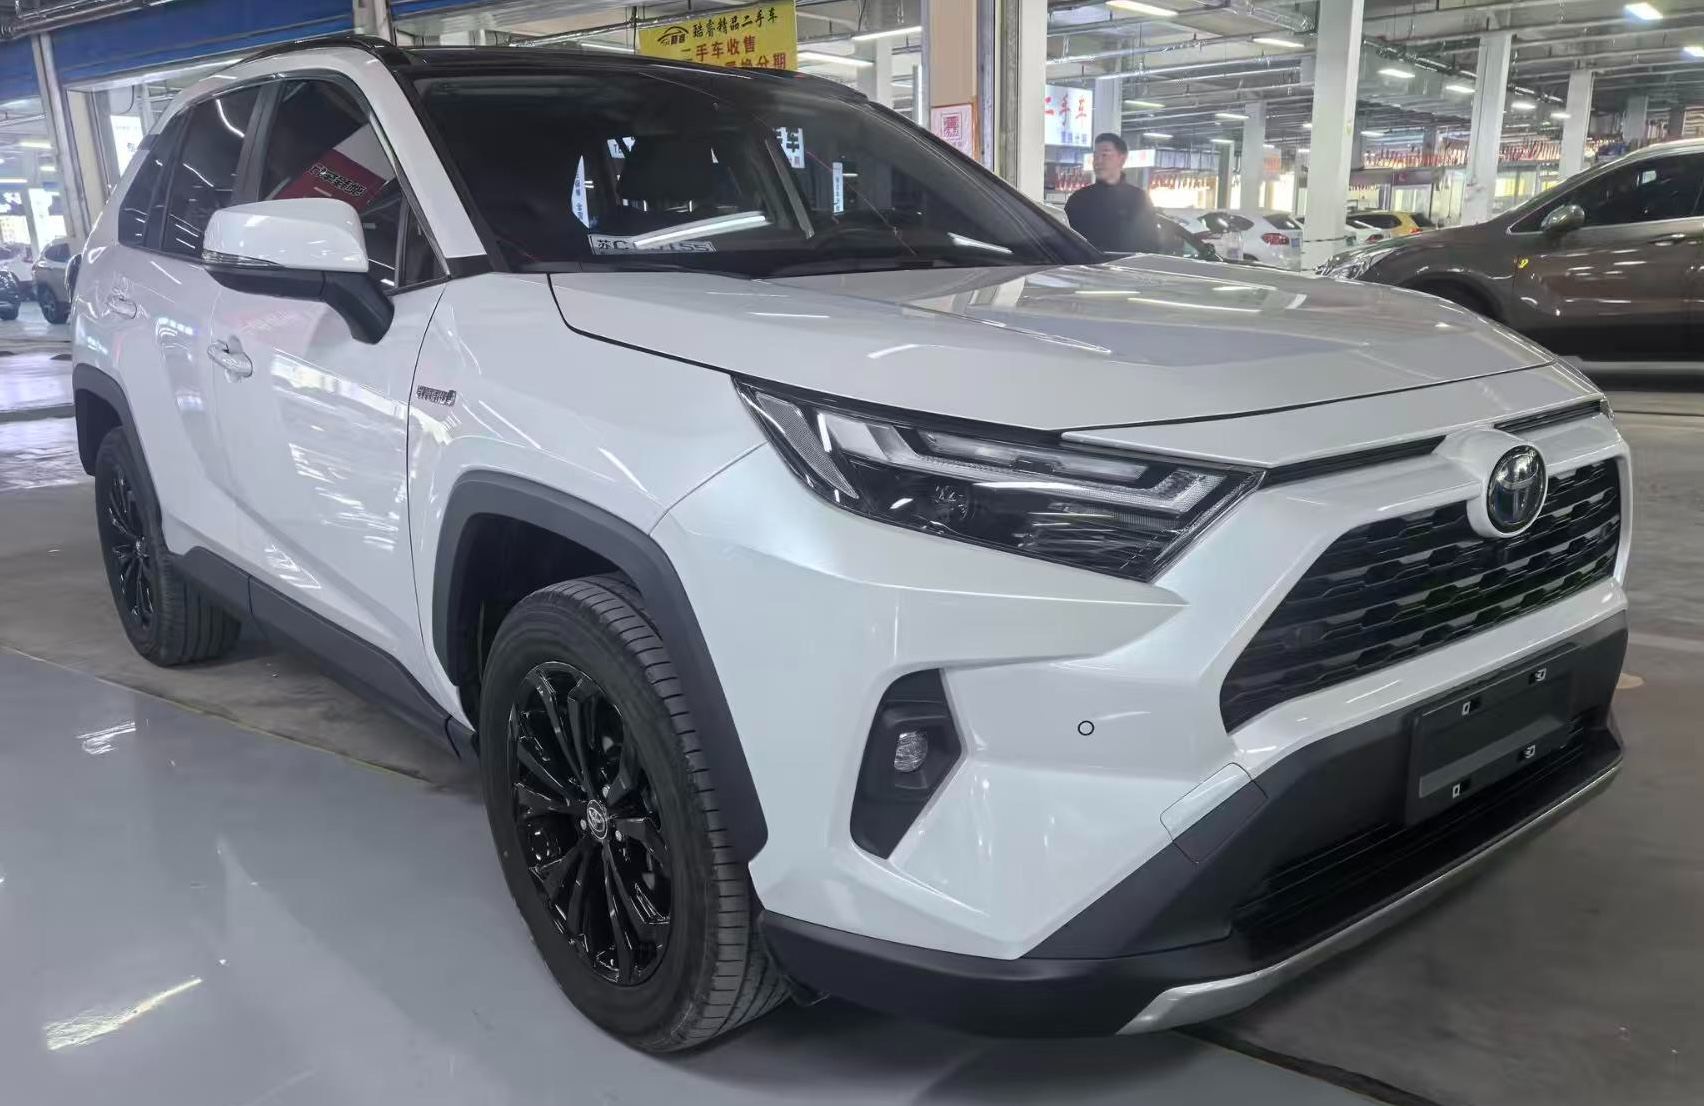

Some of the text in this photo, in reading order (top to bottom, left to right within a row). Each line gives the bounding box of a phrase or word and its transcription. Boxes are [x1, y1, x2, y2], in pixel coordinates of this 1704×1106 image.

[693, 7, 778, 38] 酷睿精品二手车
